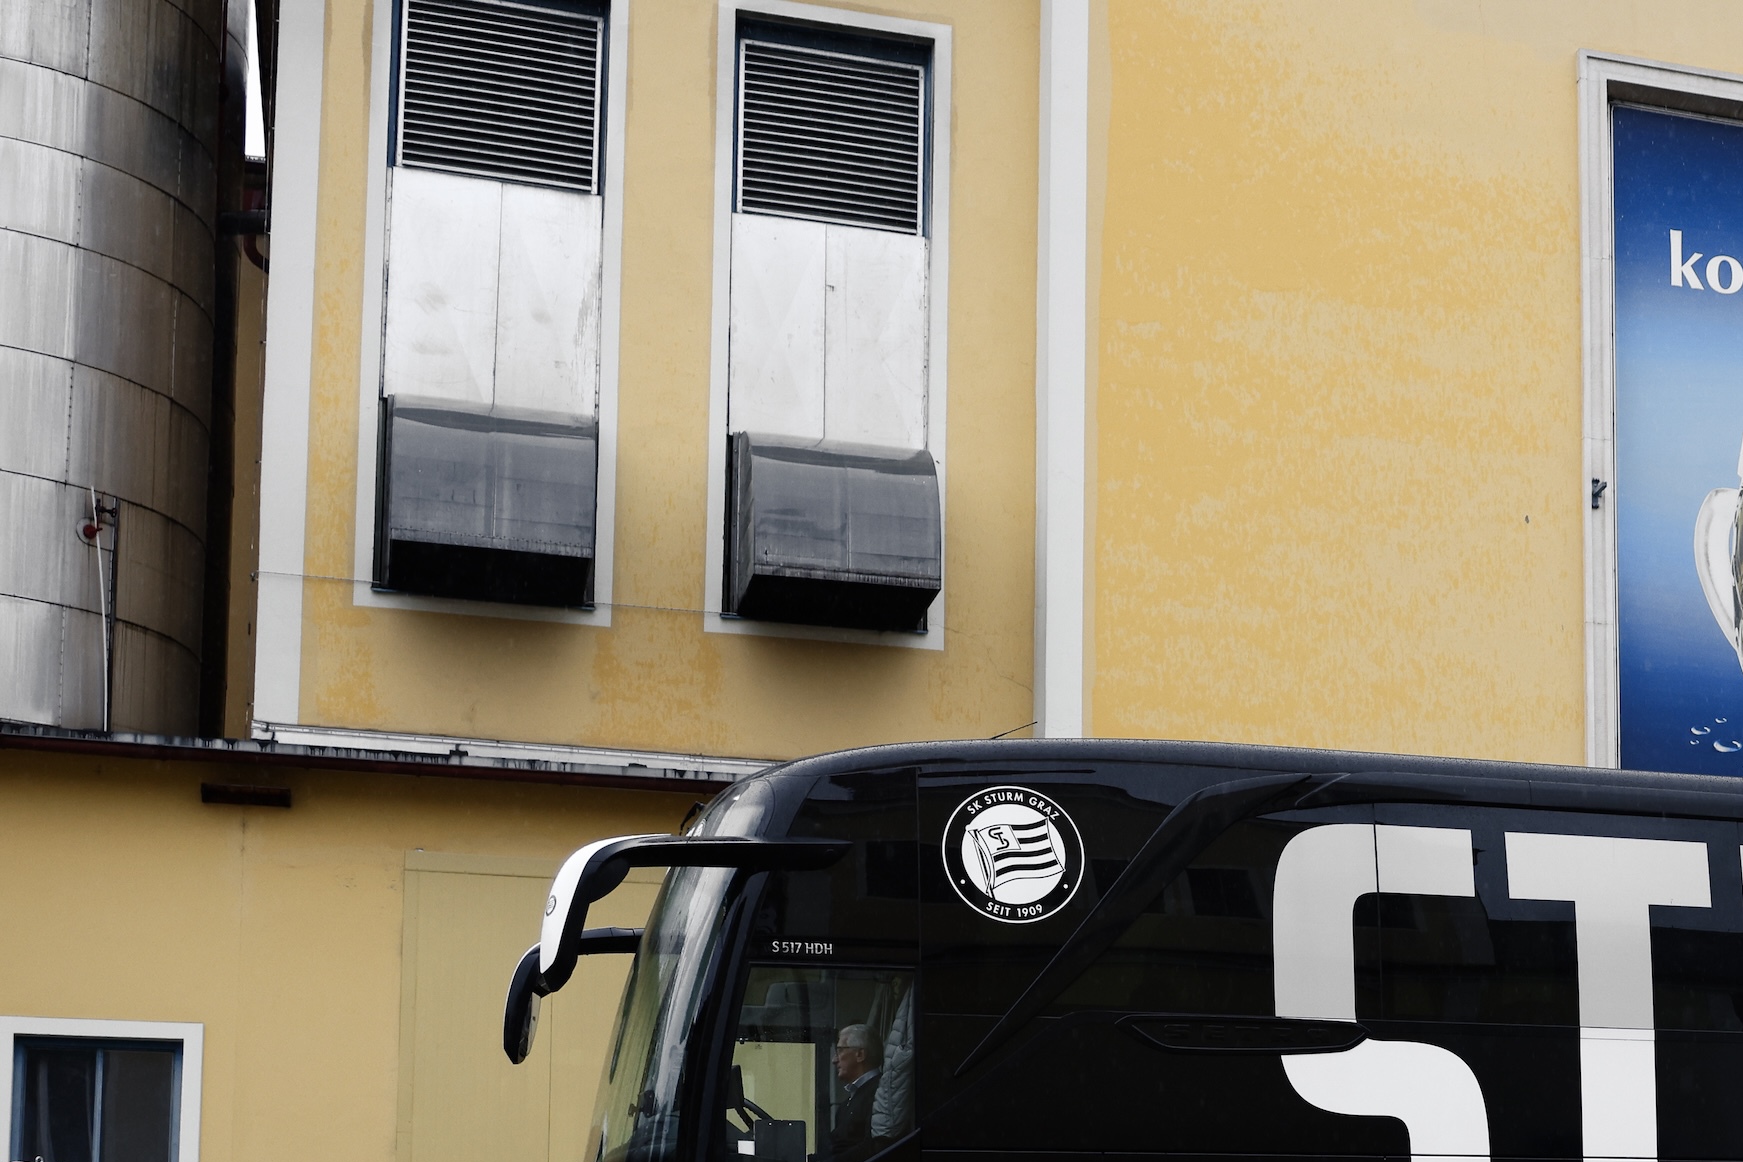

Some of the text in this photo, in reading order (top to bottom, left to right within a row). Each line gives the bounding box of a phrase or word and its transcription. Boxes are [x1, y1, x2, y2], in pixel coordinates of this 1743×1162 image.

[967, 792, 1060, 820] SK STURM GRAZ
[986, 902, 1043, 917] SEIT 1909
[772, 941, 832, 954] S 517 HDH
